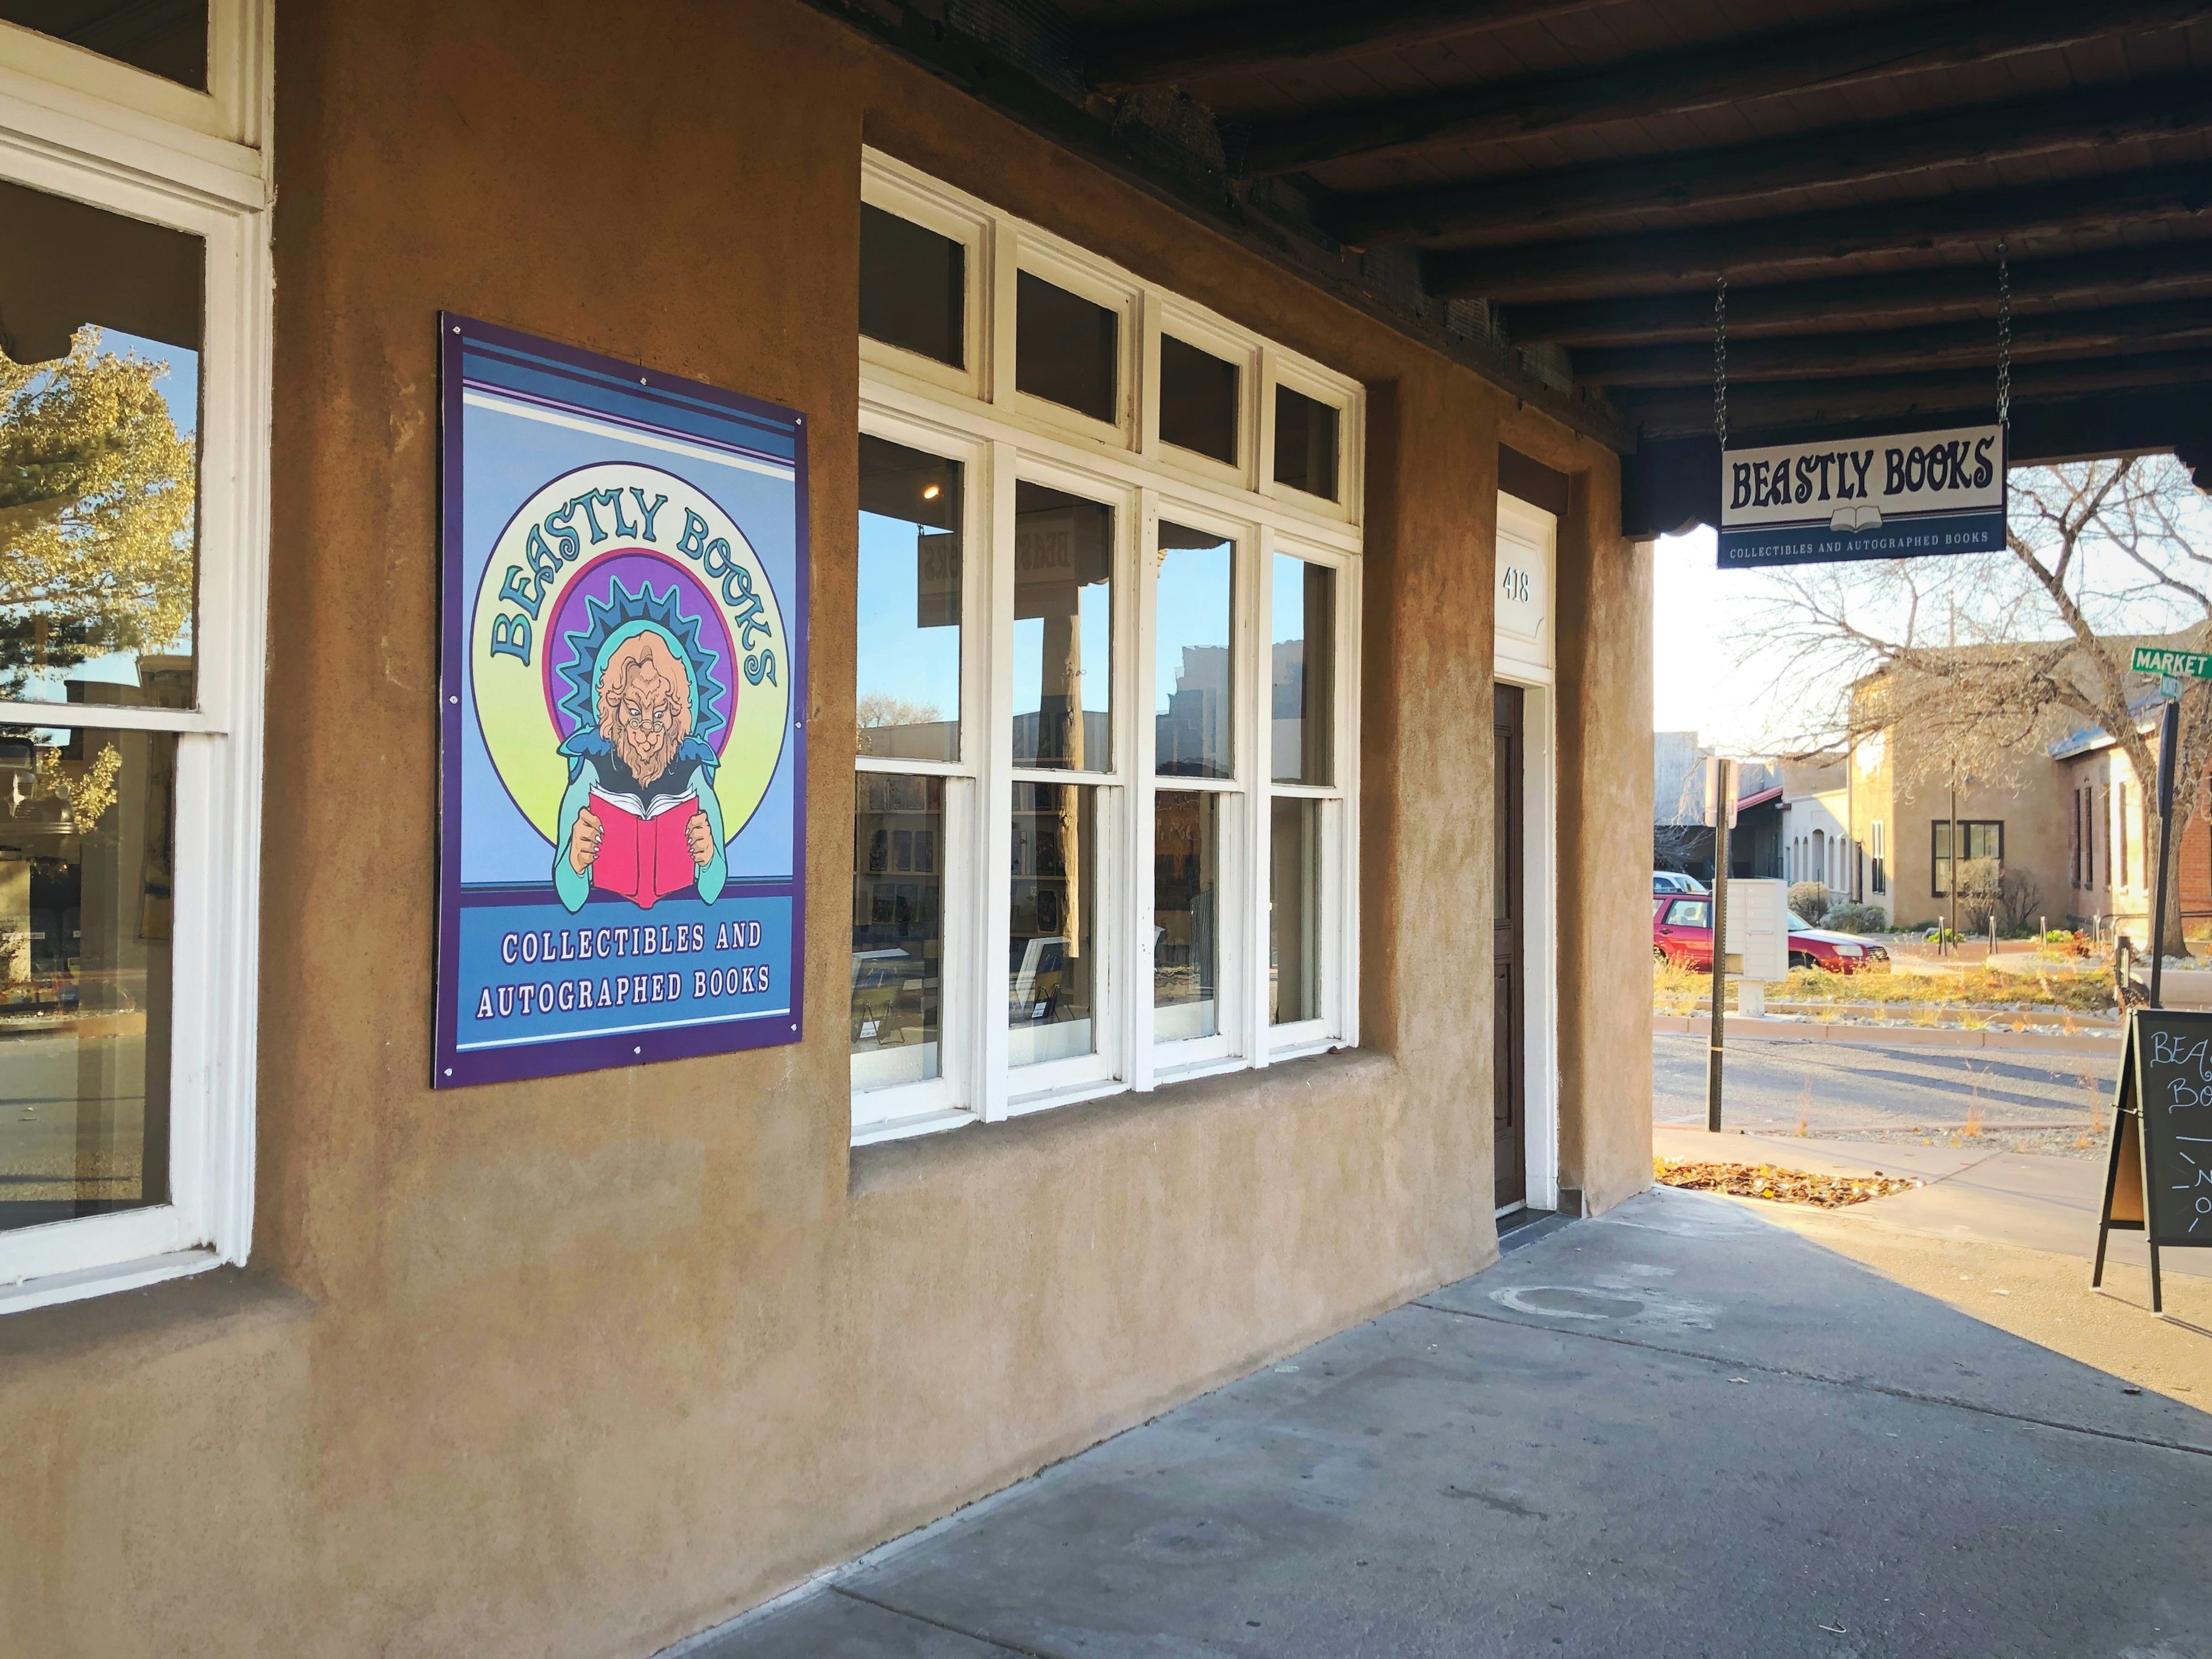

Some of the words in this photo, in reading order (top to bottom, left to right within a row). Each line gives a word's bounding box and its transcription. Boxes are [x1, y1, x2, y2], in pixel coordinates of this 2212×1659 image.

[1730, 450, 1874, 509] BEASTLY
[1883, 435, 1994, 495] BOOKS
[1730, 543, 1813, 559] COLLECTIBLES
[1818, 541, 1841, 552] AND
[1847, 535, 1939, 551] AUTOGRAPHED
[1945, 532, 1988, 545] BOOKS
[490, 486, 668, 667] BEASTLY
[676, 507, 778, 688] BOOKS
[1503, 566, 1531, 604] 418
[2136, 650, 2208, 675] MARKET
[502, 923, 704, 964] COLLECTIBLES
[715, 921, 762, 949] AND
[476, 972, 681, 1018] AUTOGRAPHED
[694, 965, 770, 998] BOOKS
[2150, 1031, 2212, 1082] BEA
